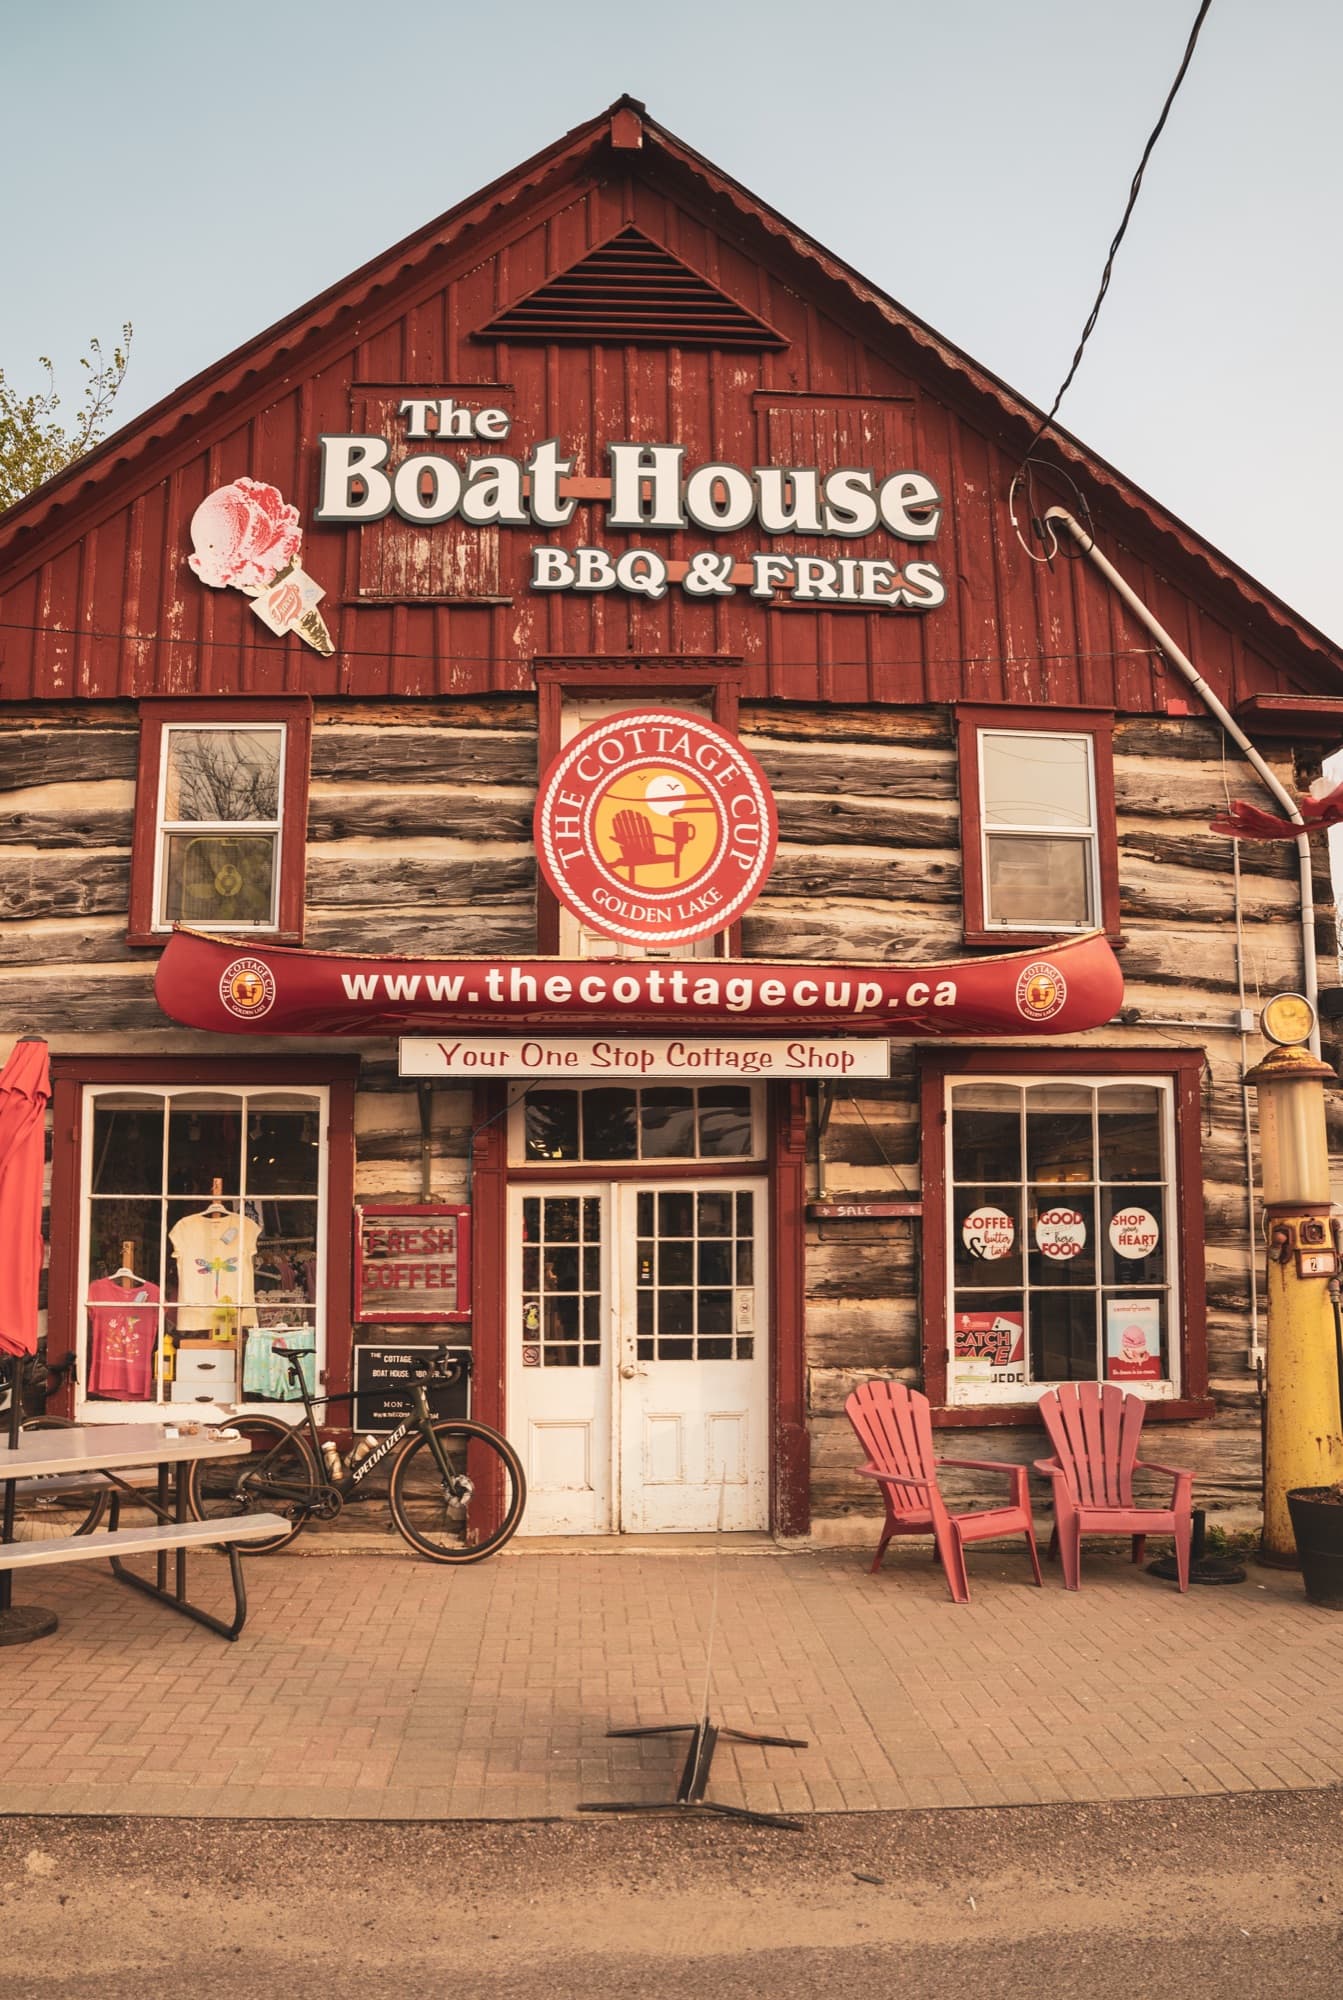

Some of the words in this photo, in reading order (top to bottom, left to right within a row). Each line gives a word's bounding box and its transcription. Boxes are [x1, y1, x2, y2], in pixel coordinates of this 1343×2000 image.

[399, 398, 511, 439] The
[315, 437, 577, 525] Boat
[608, 443, 940, 541] House
[530, 546, 667, 598] BBQ
[684, 552, 736, 595] &
[751, 554, 945, 607] FRIES
[554, 790, 586, 869] THE
[576, 727, 741, 787] COTTAGE
[730, 794, 759, 871] CUP
[591, 887, 672, 923] GOLDEN
[677, 887, 723, 919] LAKE
[228, 961, 269, 978] COTTAGE
[1023, 965, 1060, 981] COTTAGE
[341, 967, 957, 1013] www.thecottagecup.ca
[437, 1042, 510, 1067] Your
[520, 1042, 579, 1067] One
[590, 1042, 655, 1073] Stop
[666, 1042, 774, 1073] Cottage
[785, 1043, 855, 1073] Shop
[837, 1205, 873, 1217] SALE
[963, 1217, 1014, 1230] COFFEE
[1040, 1211, 1083, 1225] GOOD
[1112, 1215, 1146, 1226] SHOP
[364, 1228, 455, 1255] FRESH
[1042, 1242, 1083, 1256] FOOD
[1118, 1234, 1156, 1246] HEART
[361, 1263, 456, 1290] COFFEE
[954, 1331, 1011, 1348] CATCH
[353, 1424, 407, 1484] SPECIALIZED
